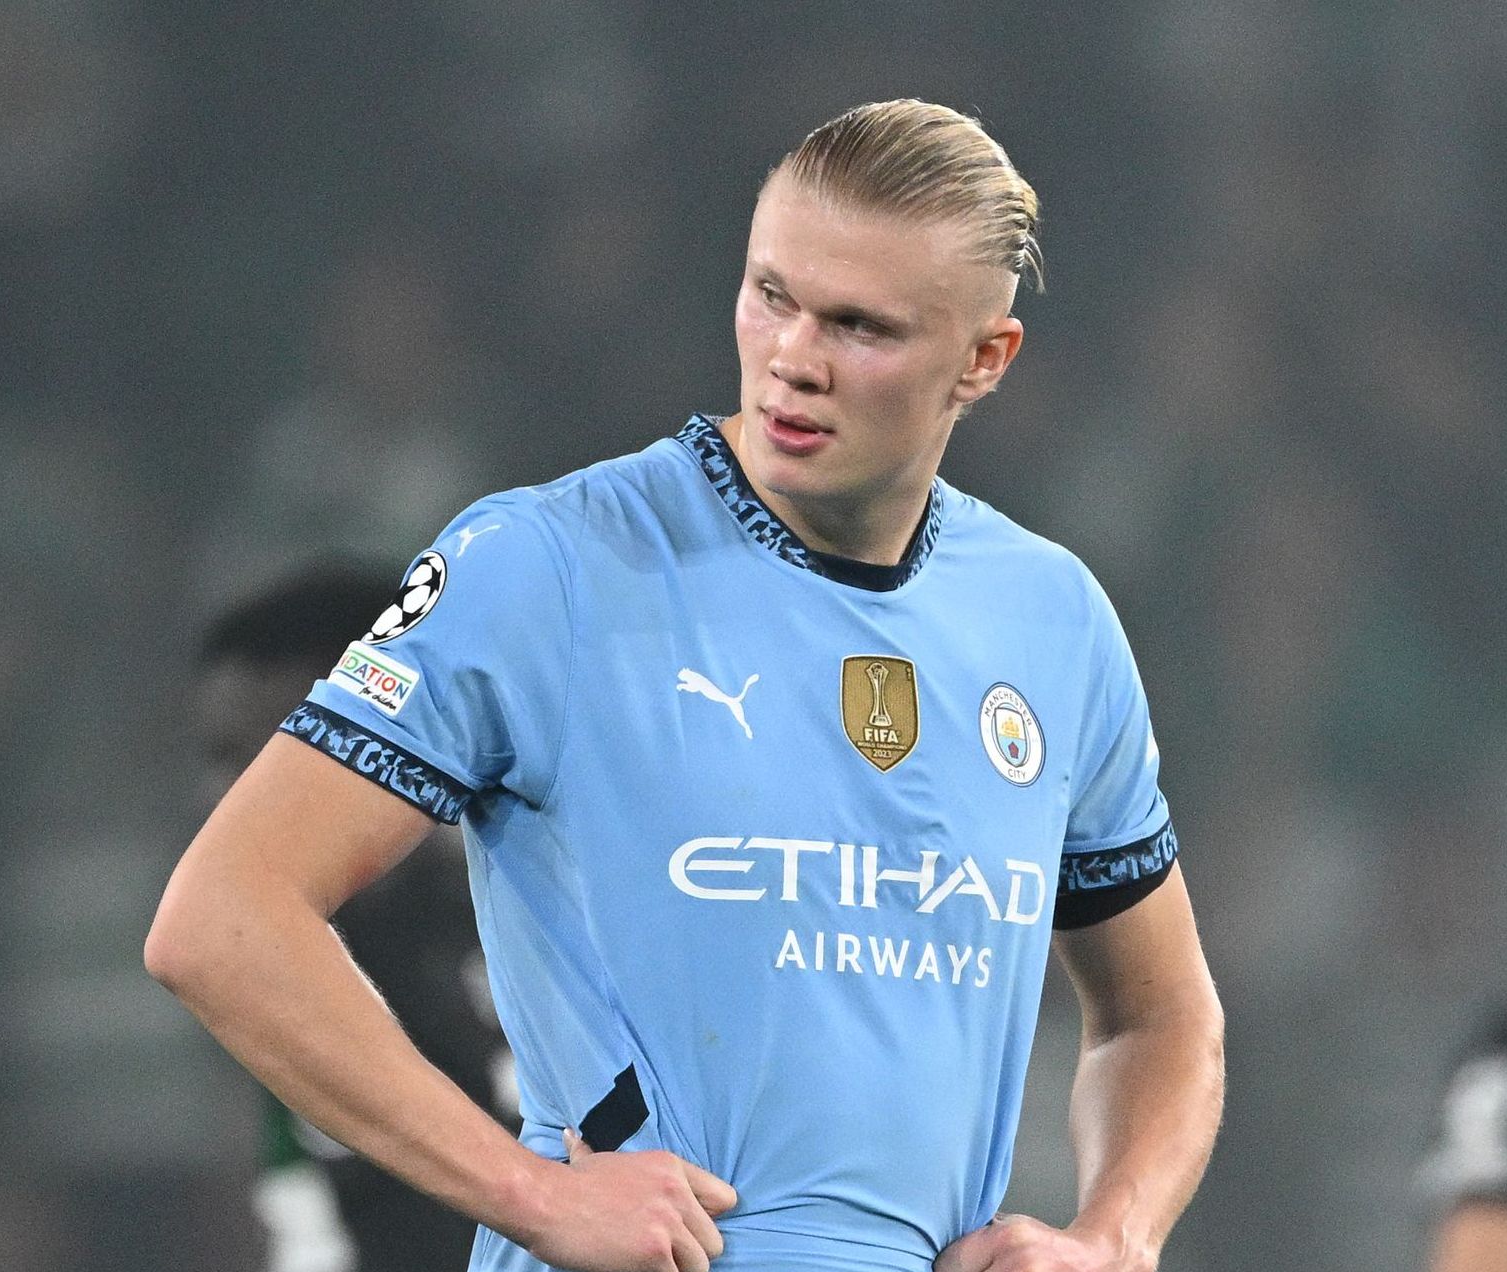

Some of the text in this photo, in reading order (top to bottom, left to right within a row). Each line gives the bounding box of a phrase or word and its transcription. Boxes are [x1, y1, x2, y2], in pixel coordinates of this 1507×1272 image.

[984, 690, 1033, 726] MANCHESTER
[864, 728, 899, 744] FIFA
[1008, 768, 1027, 779] CITY
[668, 836, 1046, 926] ETIHAD
[774, 929, 992, 988] AIRWAYS
